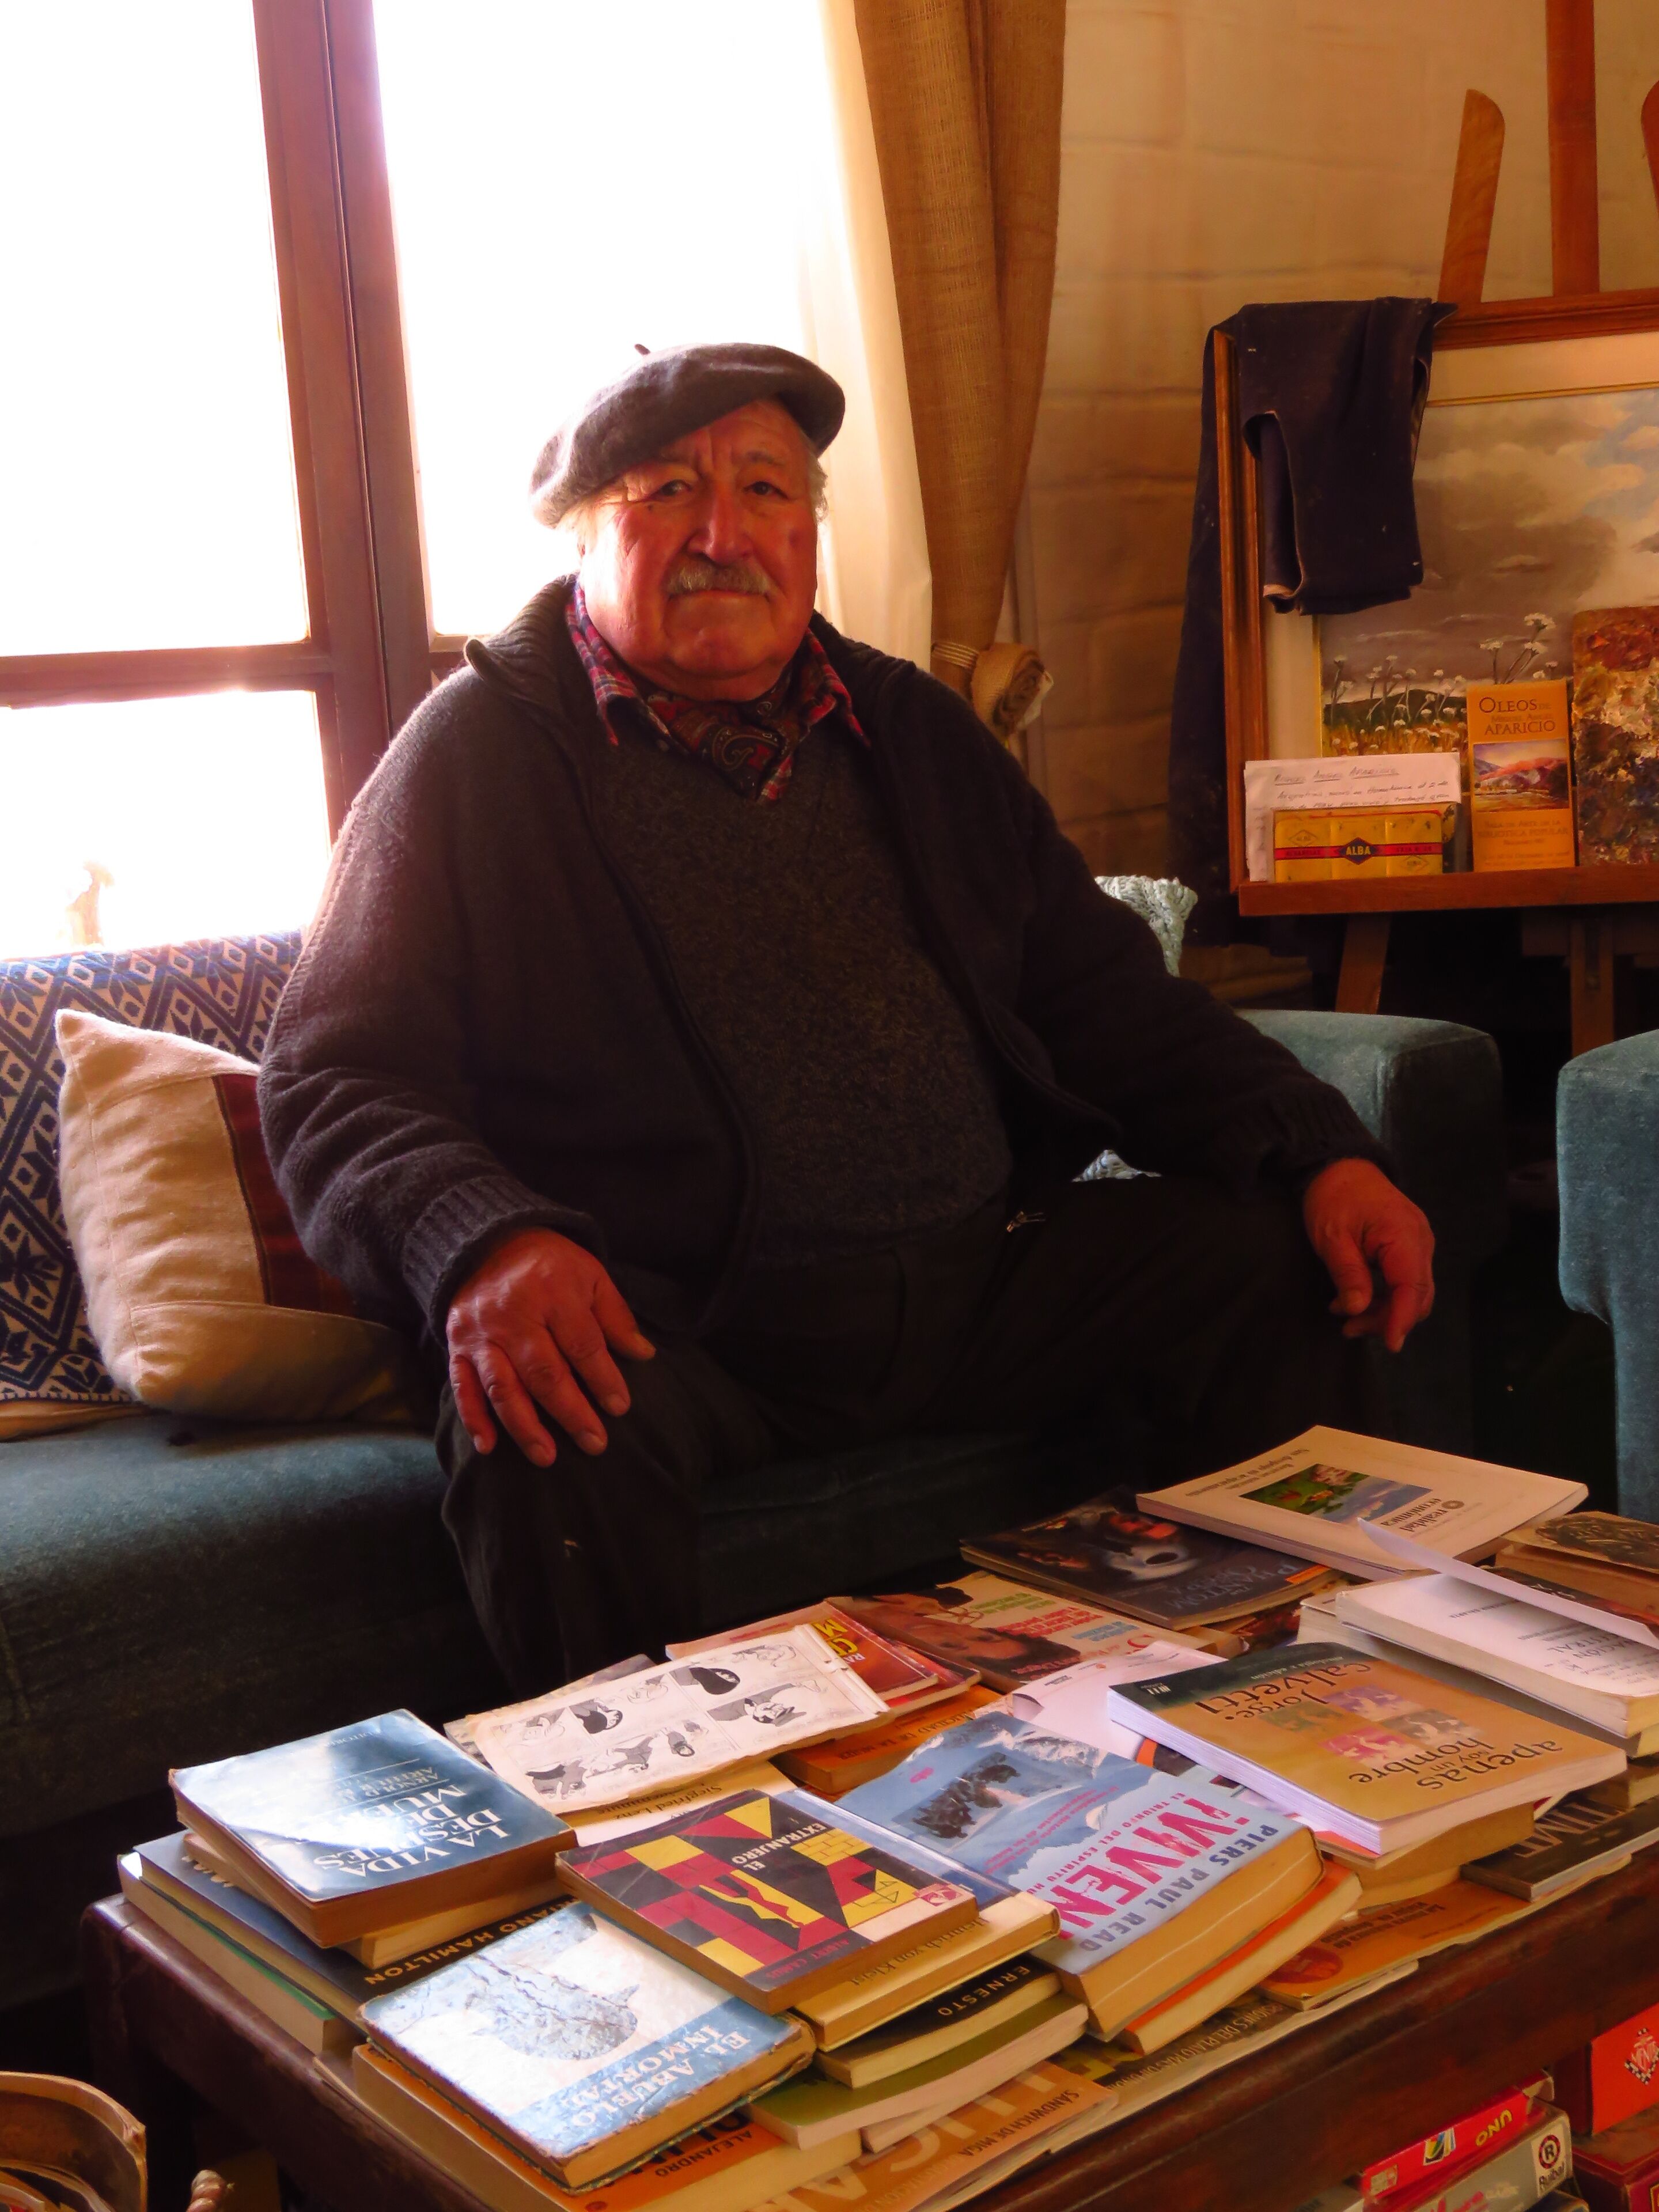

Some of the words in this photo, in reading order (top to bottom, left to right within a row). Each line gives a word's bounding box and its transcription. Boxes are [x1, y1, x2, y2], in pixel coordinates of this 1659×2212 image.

[1484, 720, 1555, 736] APARICIO
[1346, 845, 1371, 856] ALBA
[1347, 1737, 1494, 1785] hombre
[1415, 1740, 1563, 1790] apenas
[1118, 1800, 1171, 1829] TRIUNFO
[1168, 1791, 1188, 1802] EL
[447, 1824, 511, 1848] LA
[731, 1821, 827, 1865] EXTRANJERO
[1093, 1829, 1124, 1846] DEL
[1205, 1823, 1279, 1869] PIERS
[338, 1844, 450, 1878] VIDA
[741, 1858, 767, 1872] EL
[1140, 1866, 1213, 1913] PAUL
[1075, 1909, 1146, 1956] READ
[363, 1931, 494, 1986] HAMILTON
[937, 1965, 1031, 2016] ERNESTO
[703, 2029, 750, 2058] EL
[560, 2024, 723, 2109] INMORTAL
[571, 2057, 695, 2127] ABUELO
[957, 2136, 998, 2157] MIGA
[1475, 2108, 1513, 2147] UNO
[654, 2130, 753, 2177] ALEJANDRO
